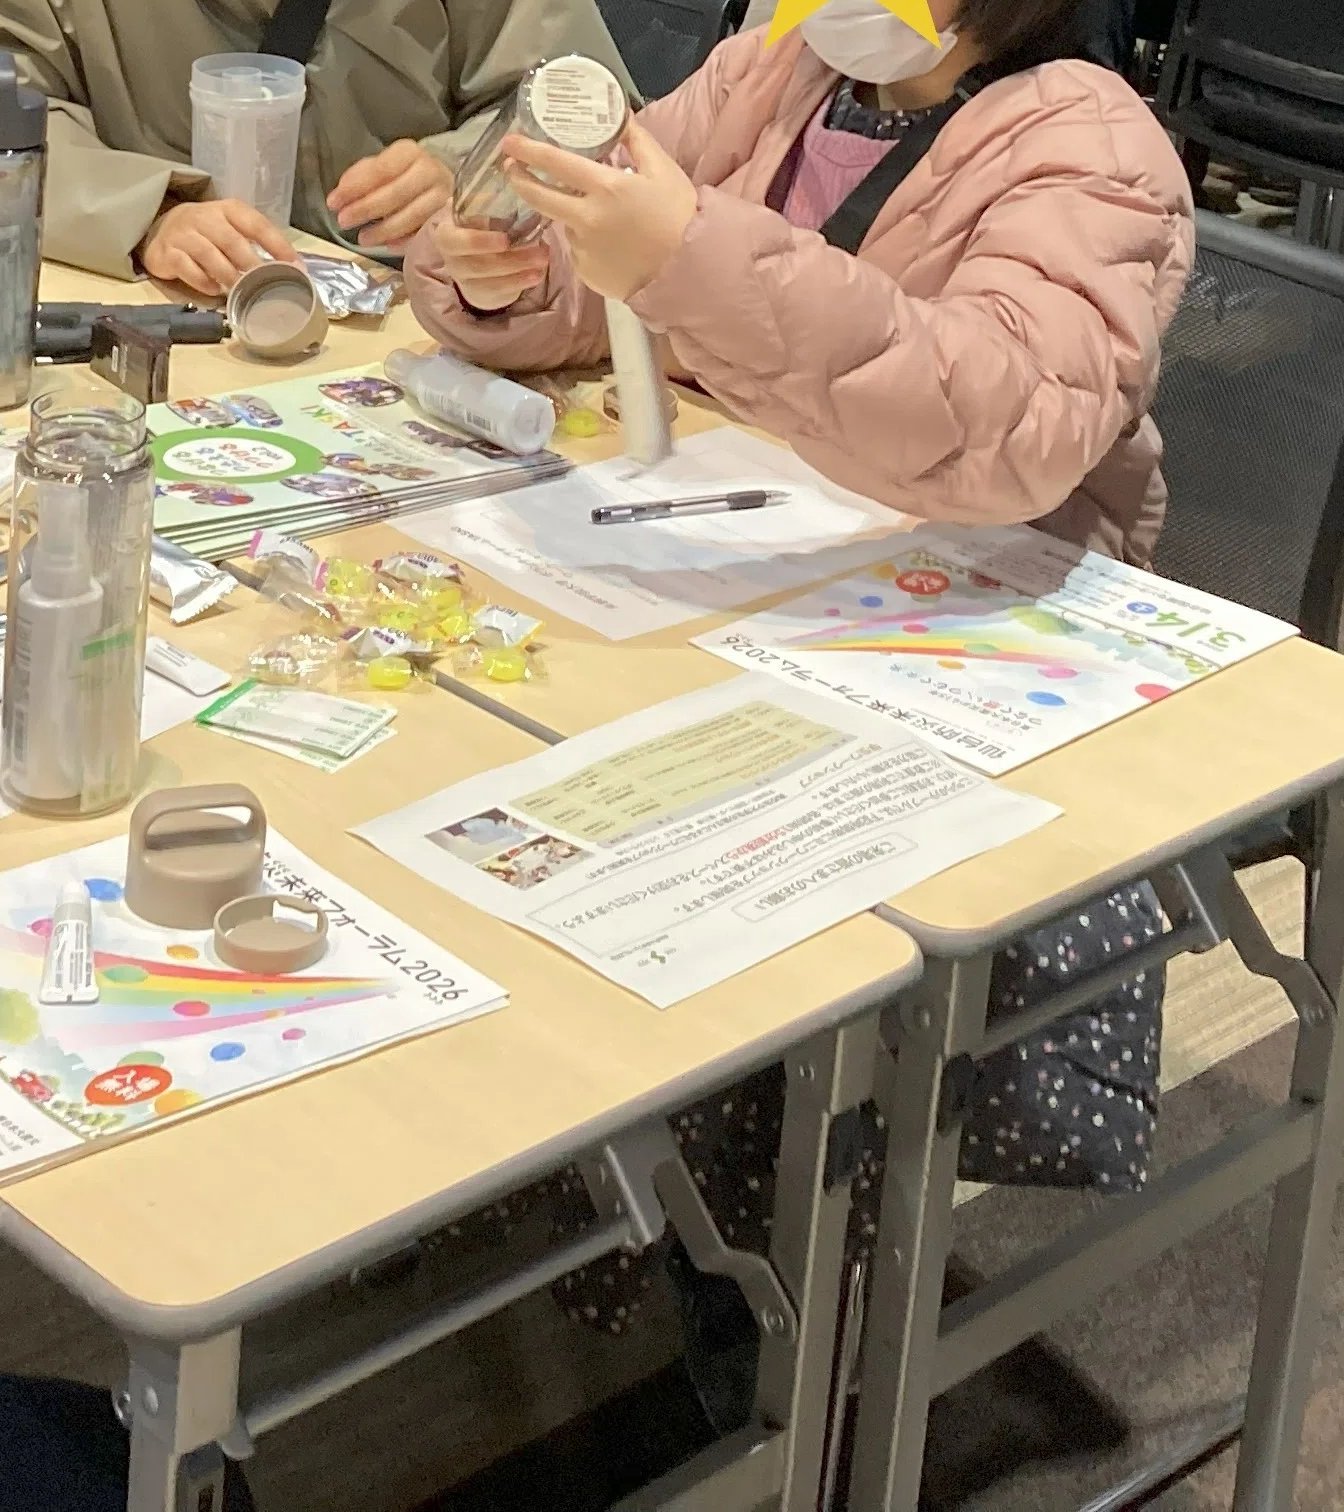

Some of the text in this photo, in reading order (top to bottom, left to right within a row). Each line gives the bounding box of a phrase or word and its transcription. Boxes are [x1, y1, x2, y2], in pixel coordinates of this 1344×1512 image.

[262, 851, 469, 1002] 災未来フォーラム2026
